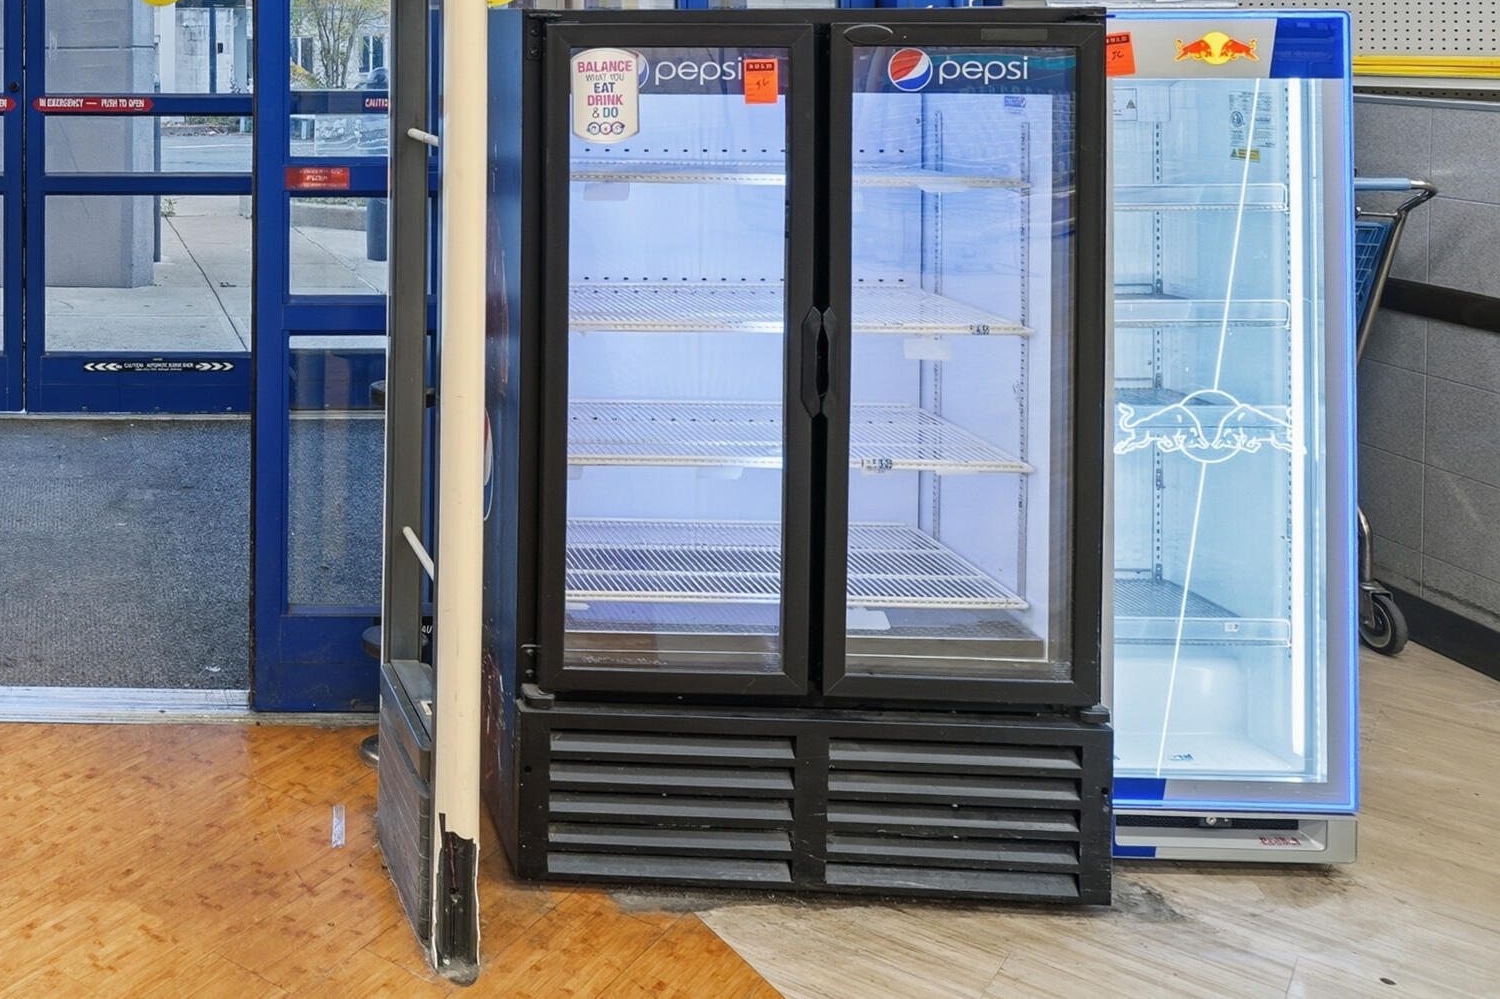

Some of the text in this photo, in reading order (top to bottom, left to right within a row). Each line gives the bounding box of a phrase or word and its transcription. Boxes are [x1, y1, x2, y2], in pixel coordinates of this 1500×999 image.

[577, 60, 632, 73] BALANCE
[655, 56, 743, 86] pepsi
[939, 56, 1028, 85] pepsi
[593, 82, 615, 93] EAT
[587, 95, 623, 106] DRINK
[592, 107, 619, 118] & DO
